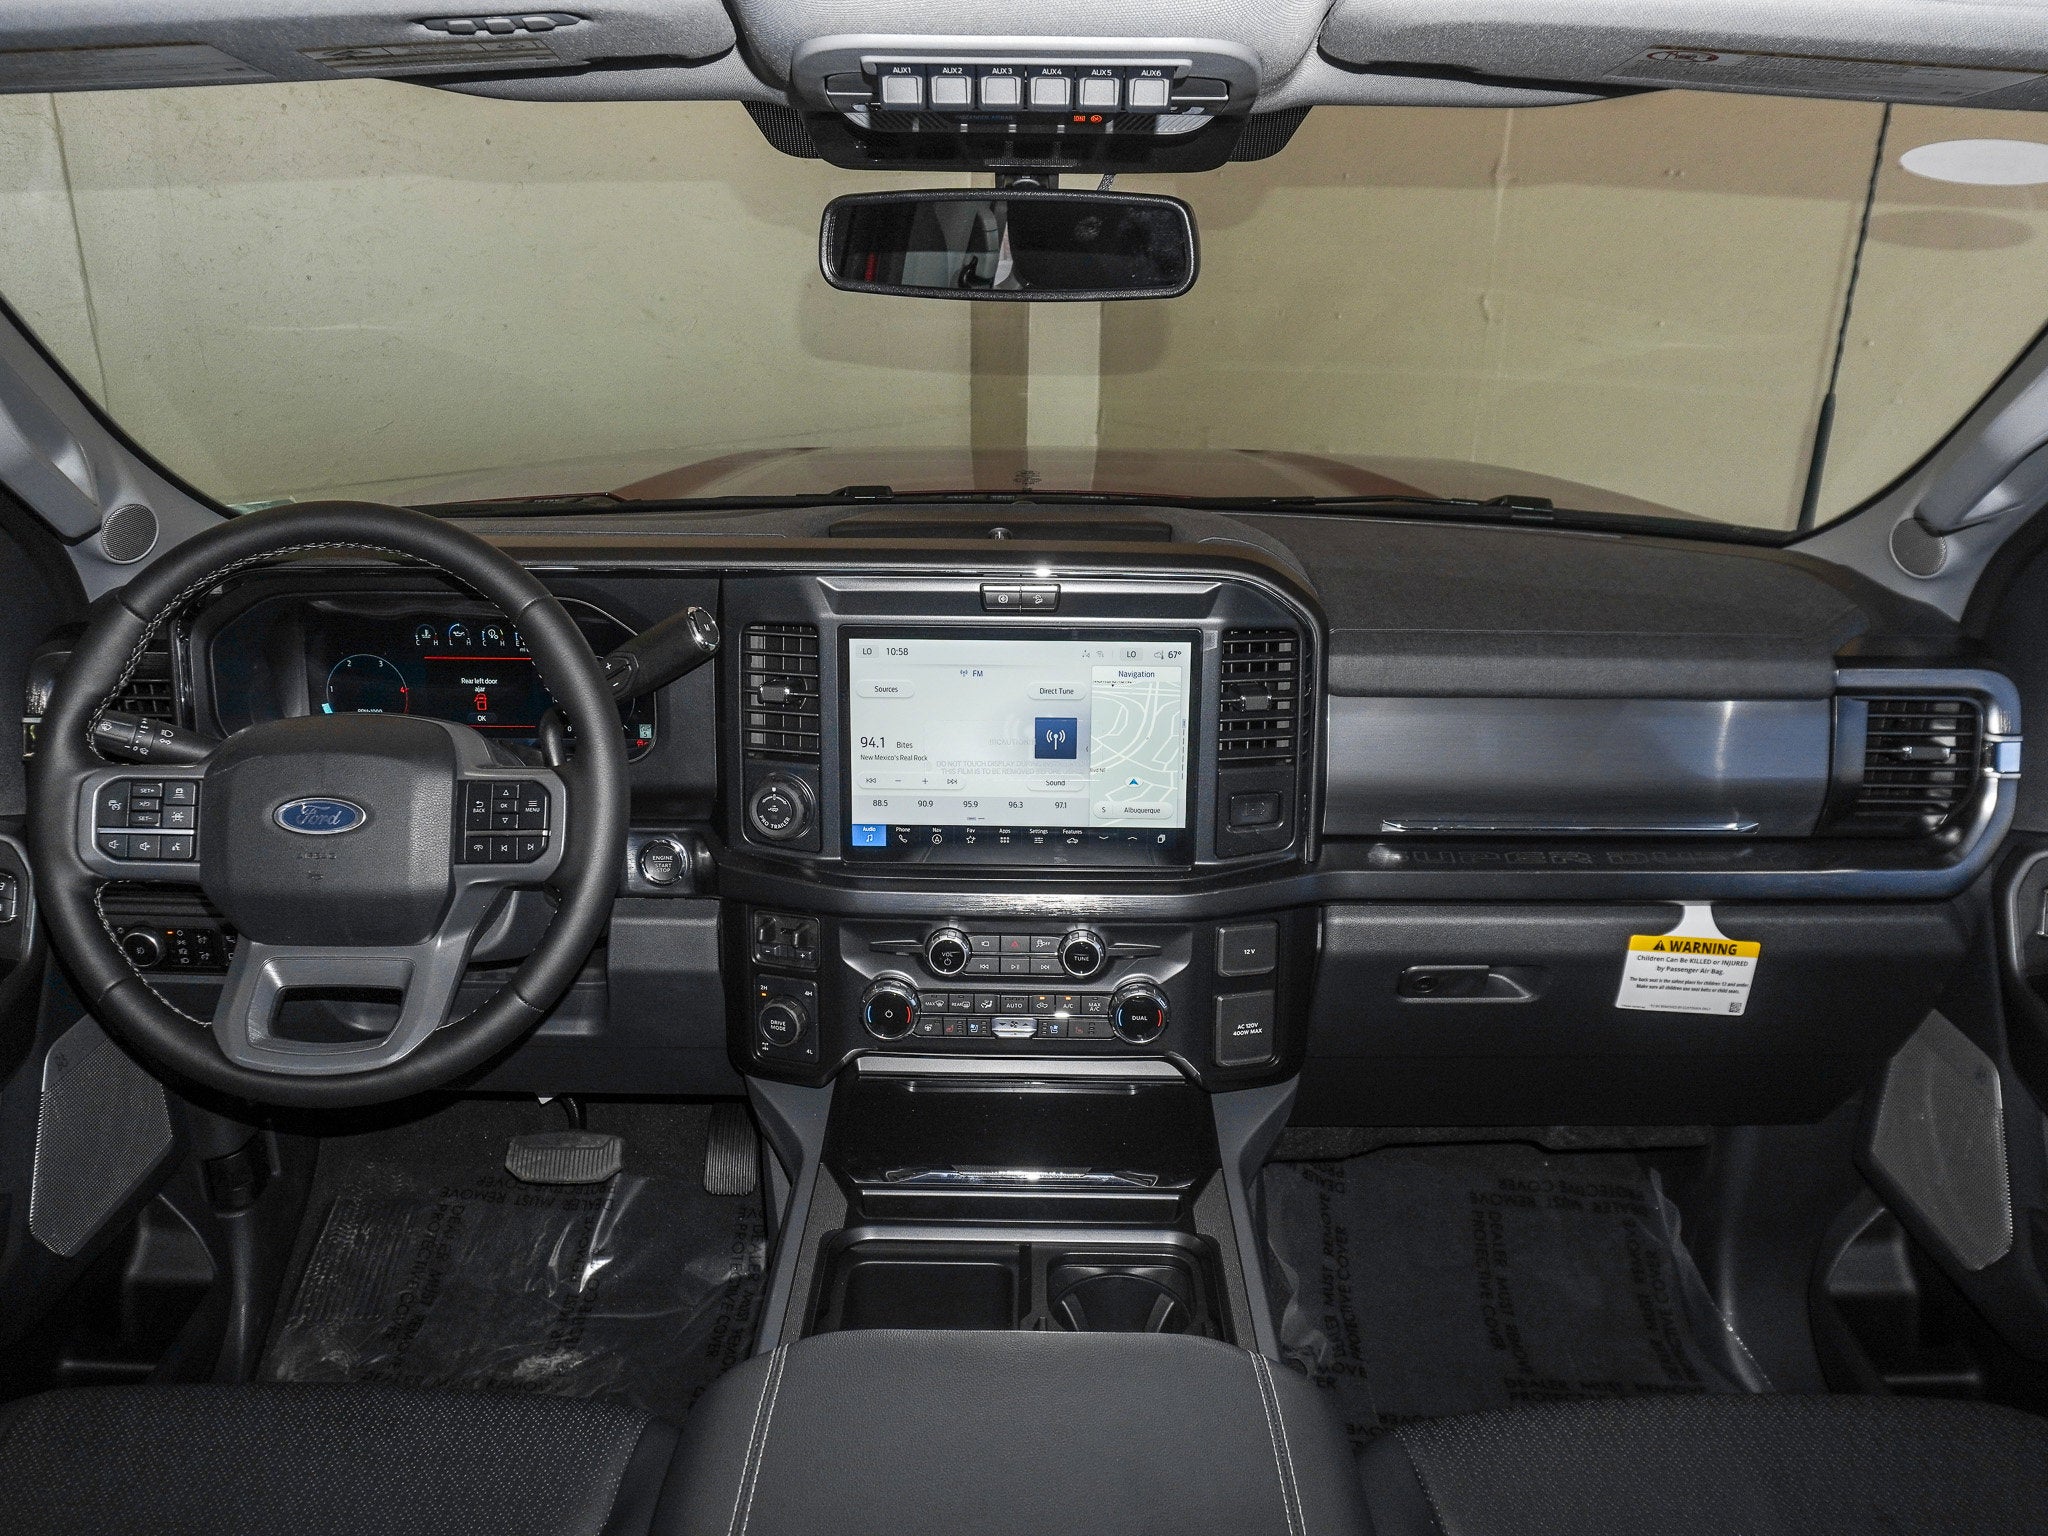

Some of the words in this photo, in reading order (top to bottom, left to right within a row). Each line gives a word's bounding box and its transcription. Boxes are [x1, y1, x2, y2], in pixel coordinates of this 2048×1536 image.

[862, 648, 872, 656] LO
[886, 648, 909, 656] 10:58
[1118, 670, 1155, 679] Navigation
[860, 736, 885, 748] 94.1
[760, 815, 769, 826] PRO
[771, 817, 791, 829] TRAILER
[1670, 940, 1738, 956] WARNING
[1666, 966, 1699, 974] Passenger
[440, 1186, 507, 1204] REMOVE
[513, 1194, 555, 1208] MUST
[1319, 1193, 1335, 1257] REMOVE
[1335, 1226, 1351, 1282] COVER
[1322, 1266, 1334, 1308] MUST
[706, 1314, 730, 1358] COVER
